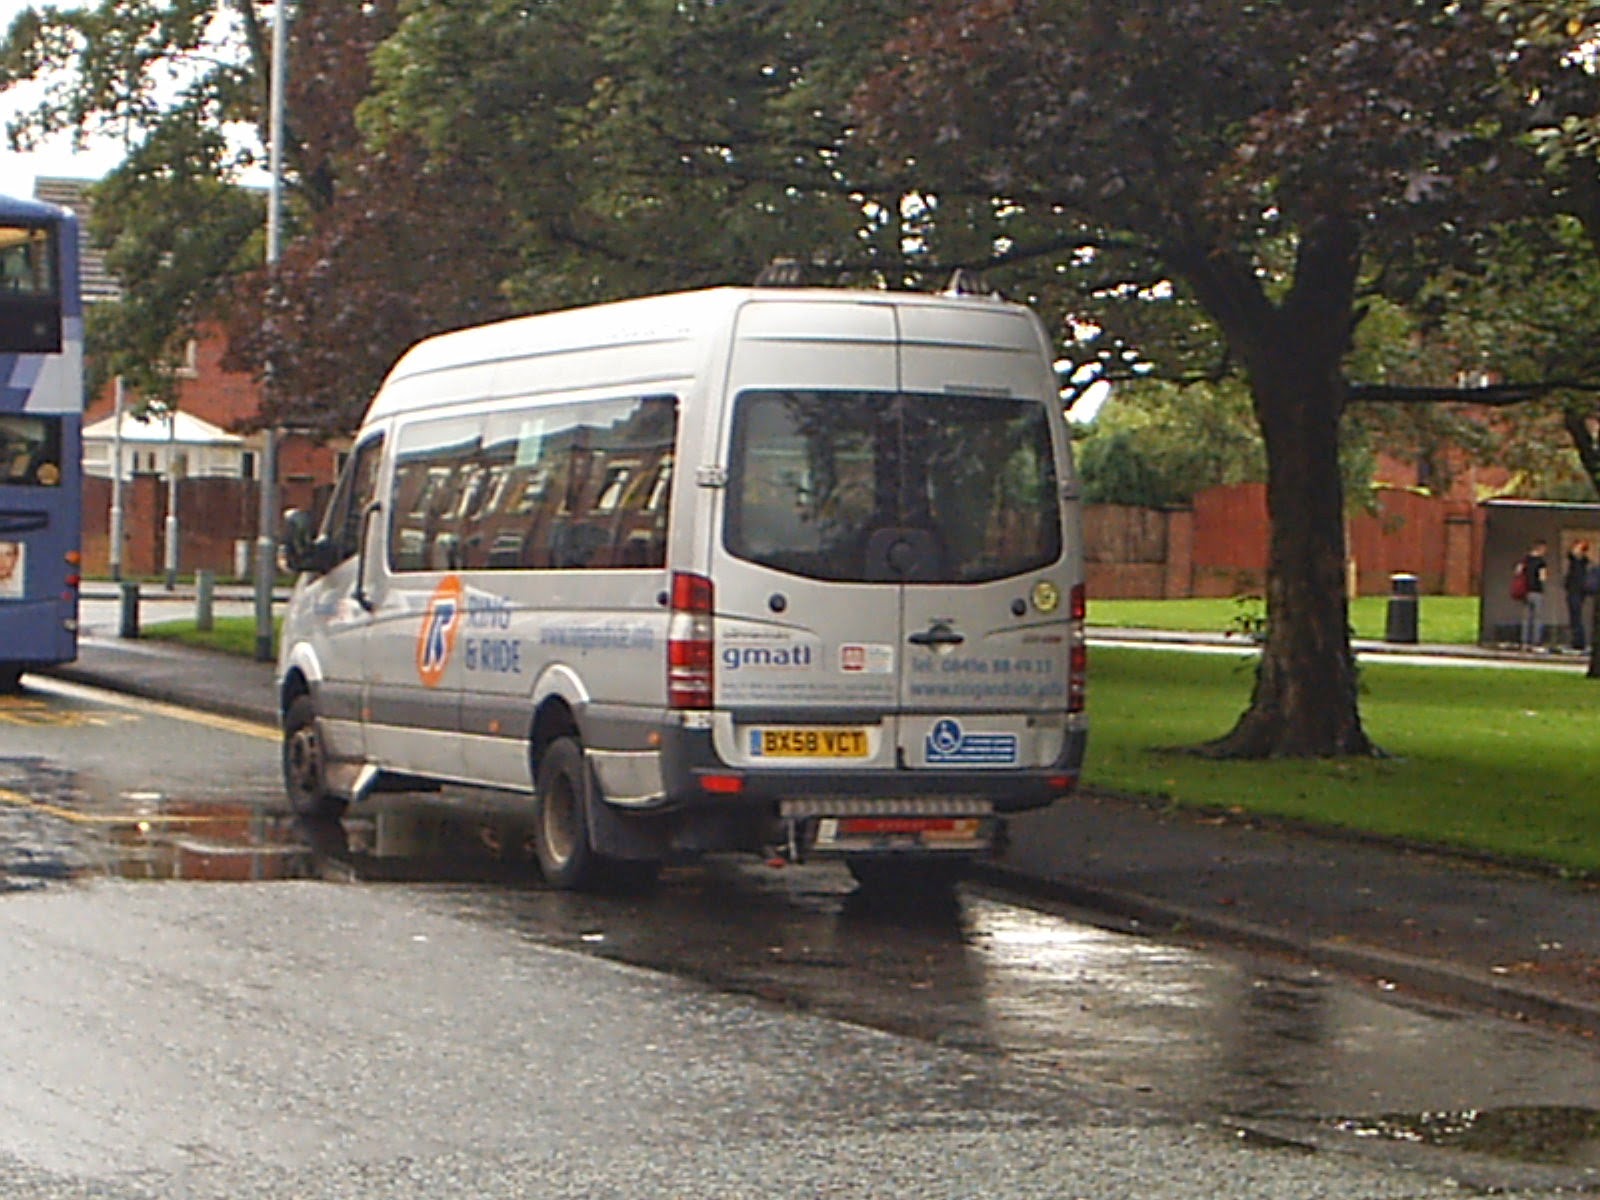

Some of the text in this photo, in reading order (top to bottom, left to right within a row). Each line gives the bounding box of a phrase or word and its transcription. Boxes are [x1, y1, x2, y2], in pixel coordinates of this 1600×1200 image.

[481, 638, 522, 674] RIDE
[763, 731, 866, 752] BX58 VCT
